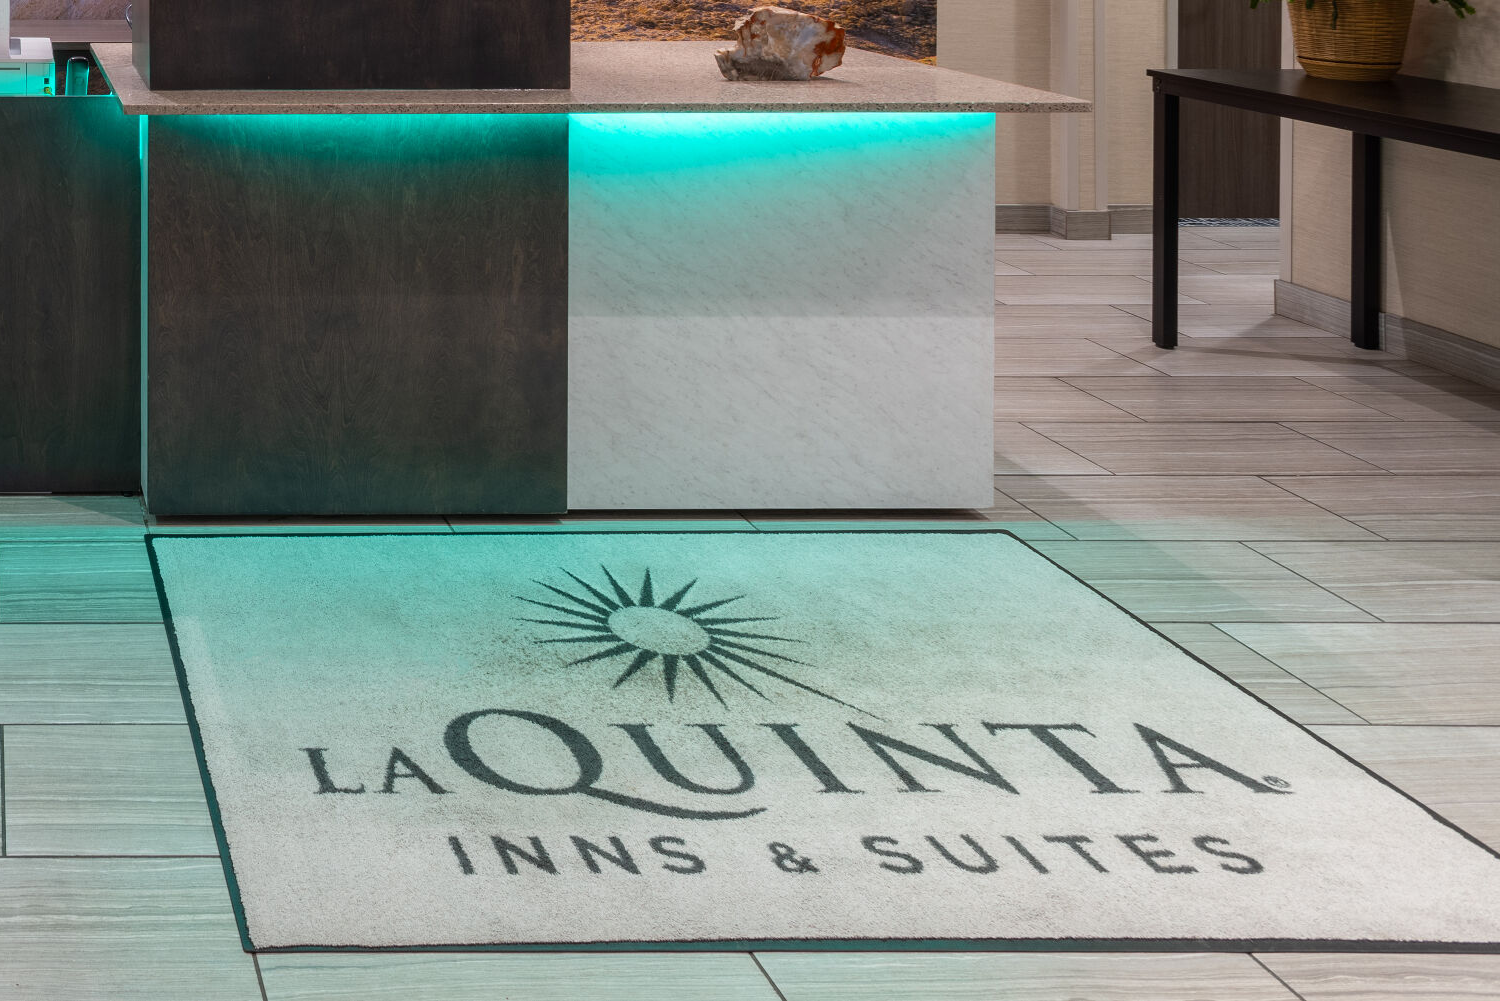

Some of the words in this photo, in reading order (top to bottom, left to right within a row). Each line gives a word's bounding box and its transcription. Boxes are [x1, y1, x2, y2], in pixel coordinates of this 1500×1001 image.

[300, 747, 456, 794] LA
[448, 835, 707, 875] INNS
[769, 841, 819, 874] &
[862, 834, 1264, 875] SUITES
